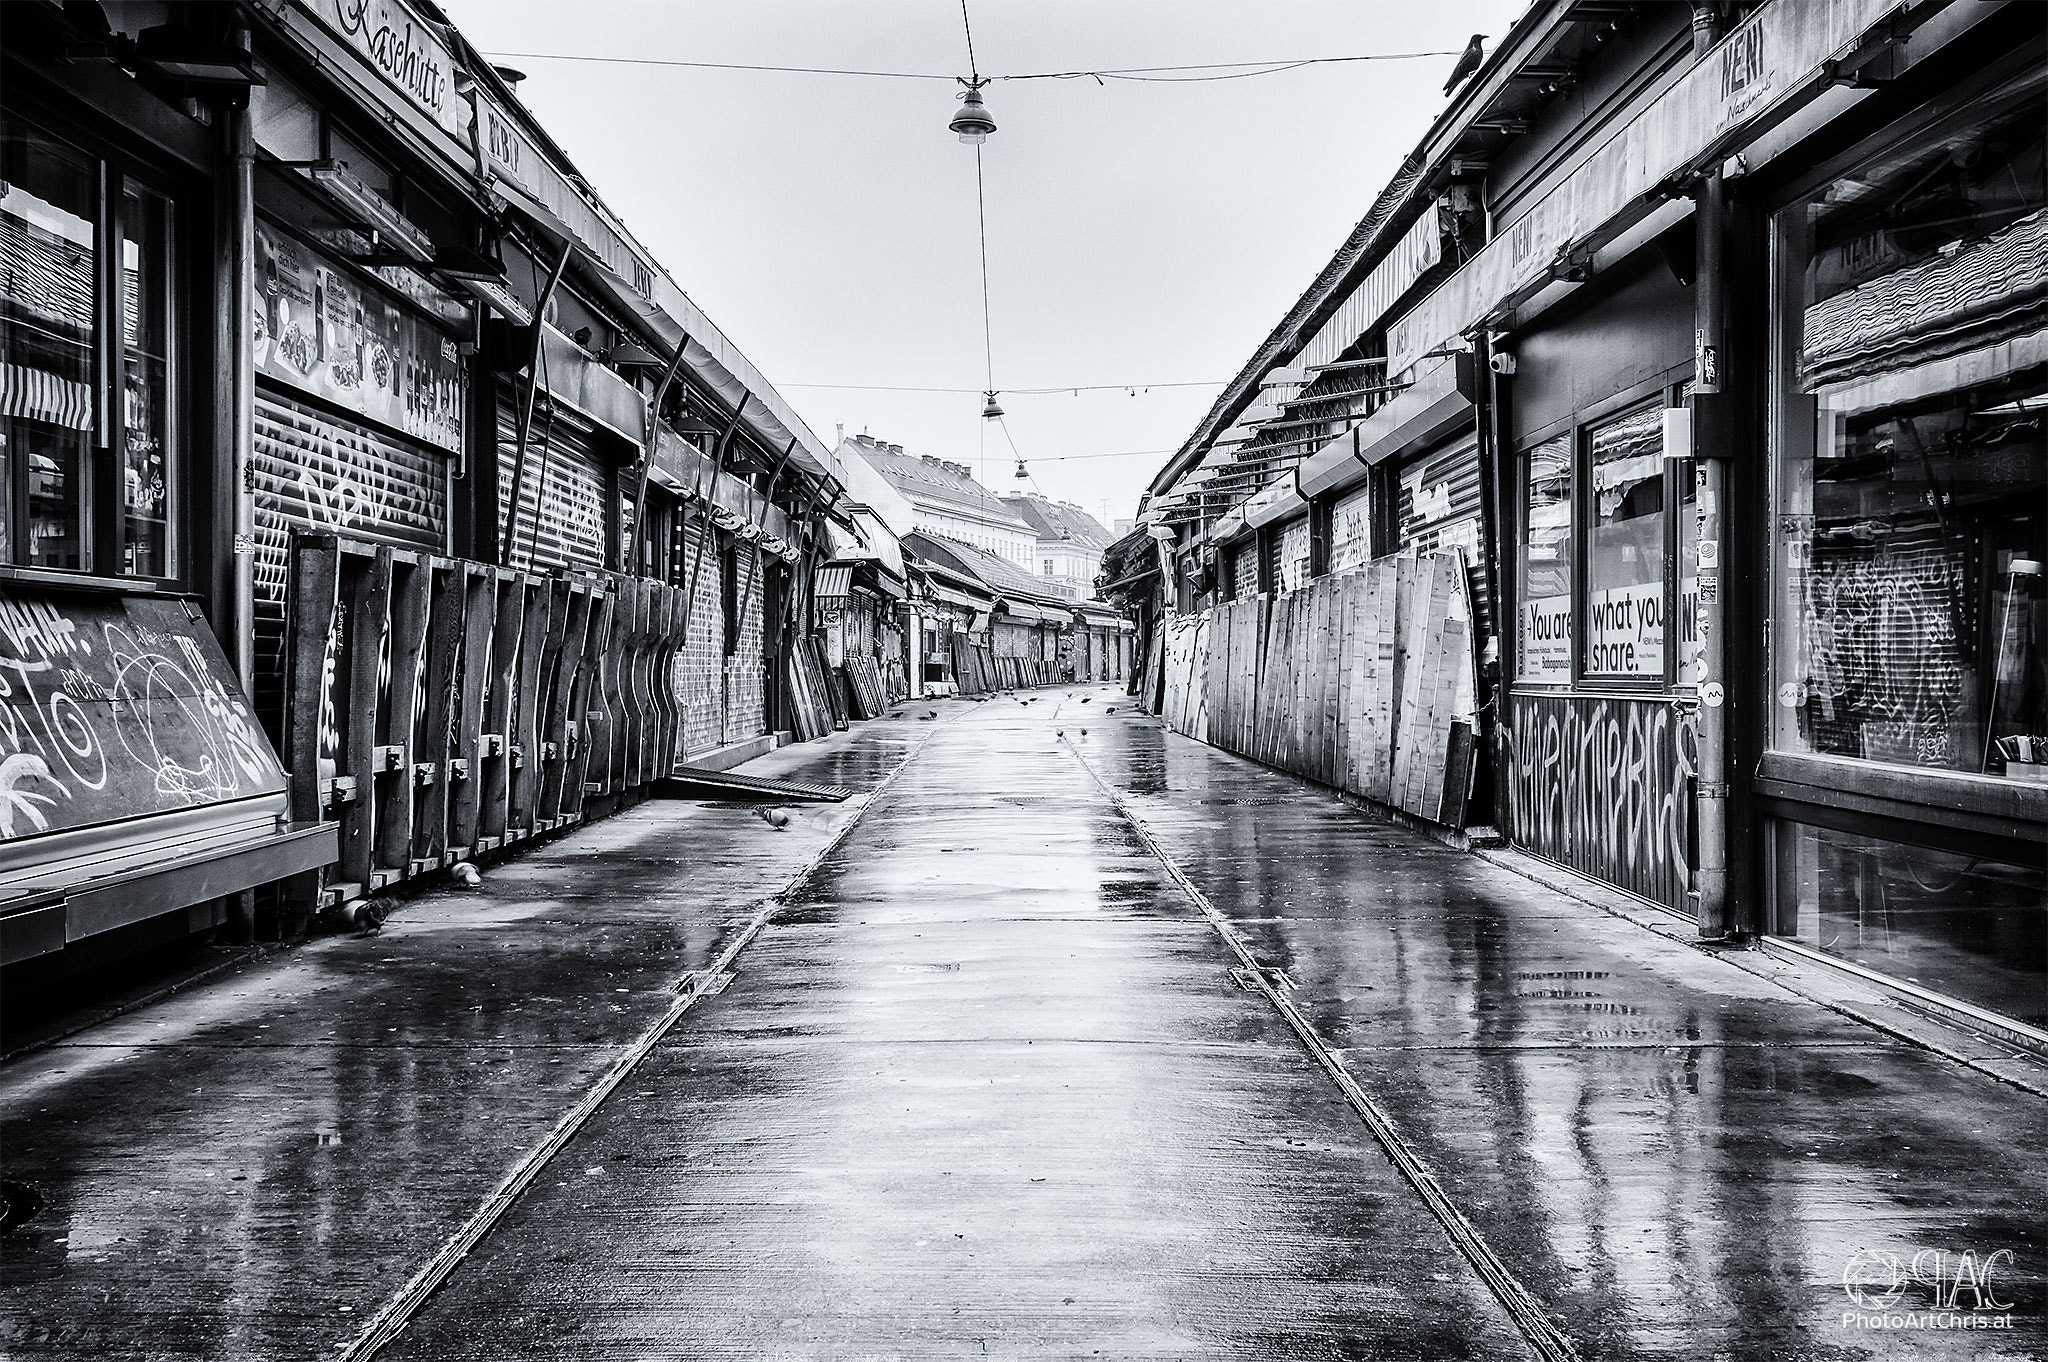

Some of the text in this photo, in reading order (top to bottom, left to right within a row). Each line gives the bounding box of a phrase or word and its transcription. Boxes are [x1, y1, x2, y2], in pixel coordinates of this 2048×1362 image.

[1721, 15, 1764, 103] NENI
[1512, 215, 1533, 269] NENI
[1530, 603, 1571, 640] You are
[1592, 588, 1633, 631] what
[1636, 596, 1664, 643] you
[1592, 629, 1639, 673] share.
